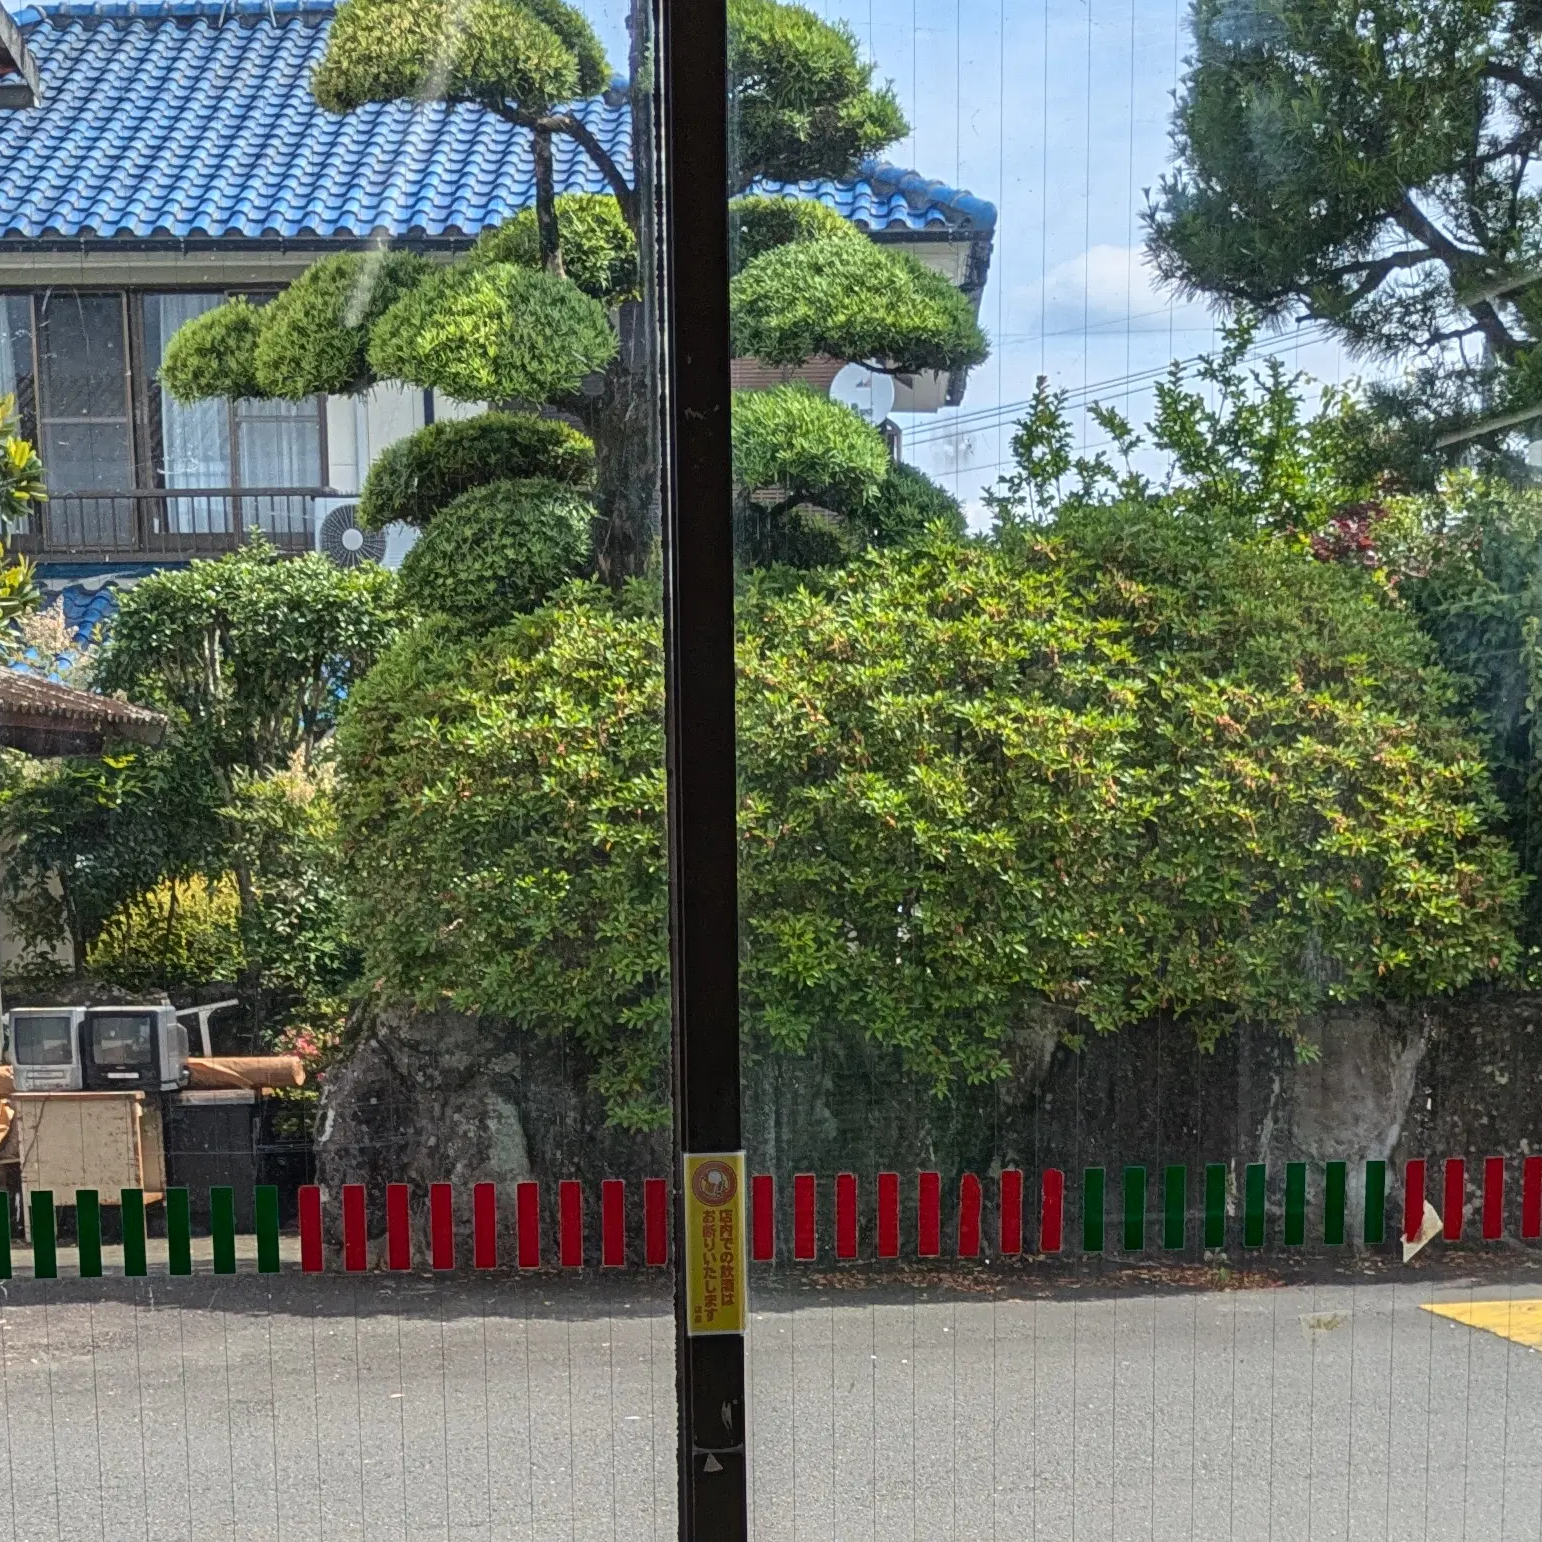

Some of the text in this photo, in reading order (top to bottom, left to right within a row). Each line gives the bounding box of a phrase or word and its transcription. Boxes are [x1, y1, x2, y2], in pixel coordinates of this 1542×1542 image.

[702, 1210, 718, 1322] お断りいたします
[719, 1209, 735, 1306] 店内での飲酒は
